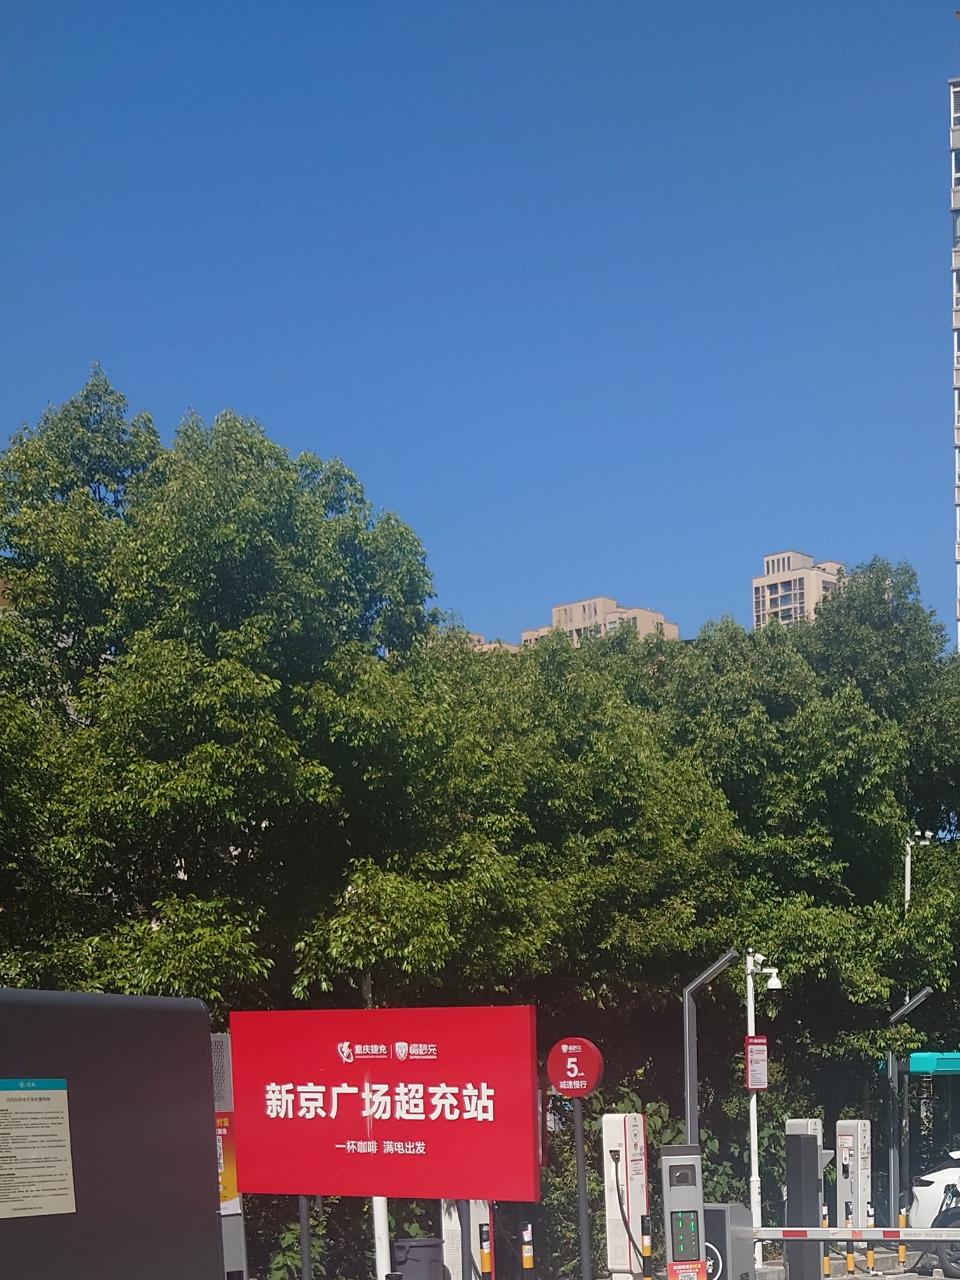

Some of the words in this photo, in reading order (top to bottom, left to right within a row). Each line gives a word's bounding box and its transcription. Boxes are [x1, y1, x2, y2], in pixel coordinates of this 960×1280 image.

[566, 1057, 579, 1078] 5
[265, 1082, 495, 1122] 新京广场超充站
[335, 1140, 378, 1154] 一杯咖啡
[383, 1140, 426, 1155] 满电出发
